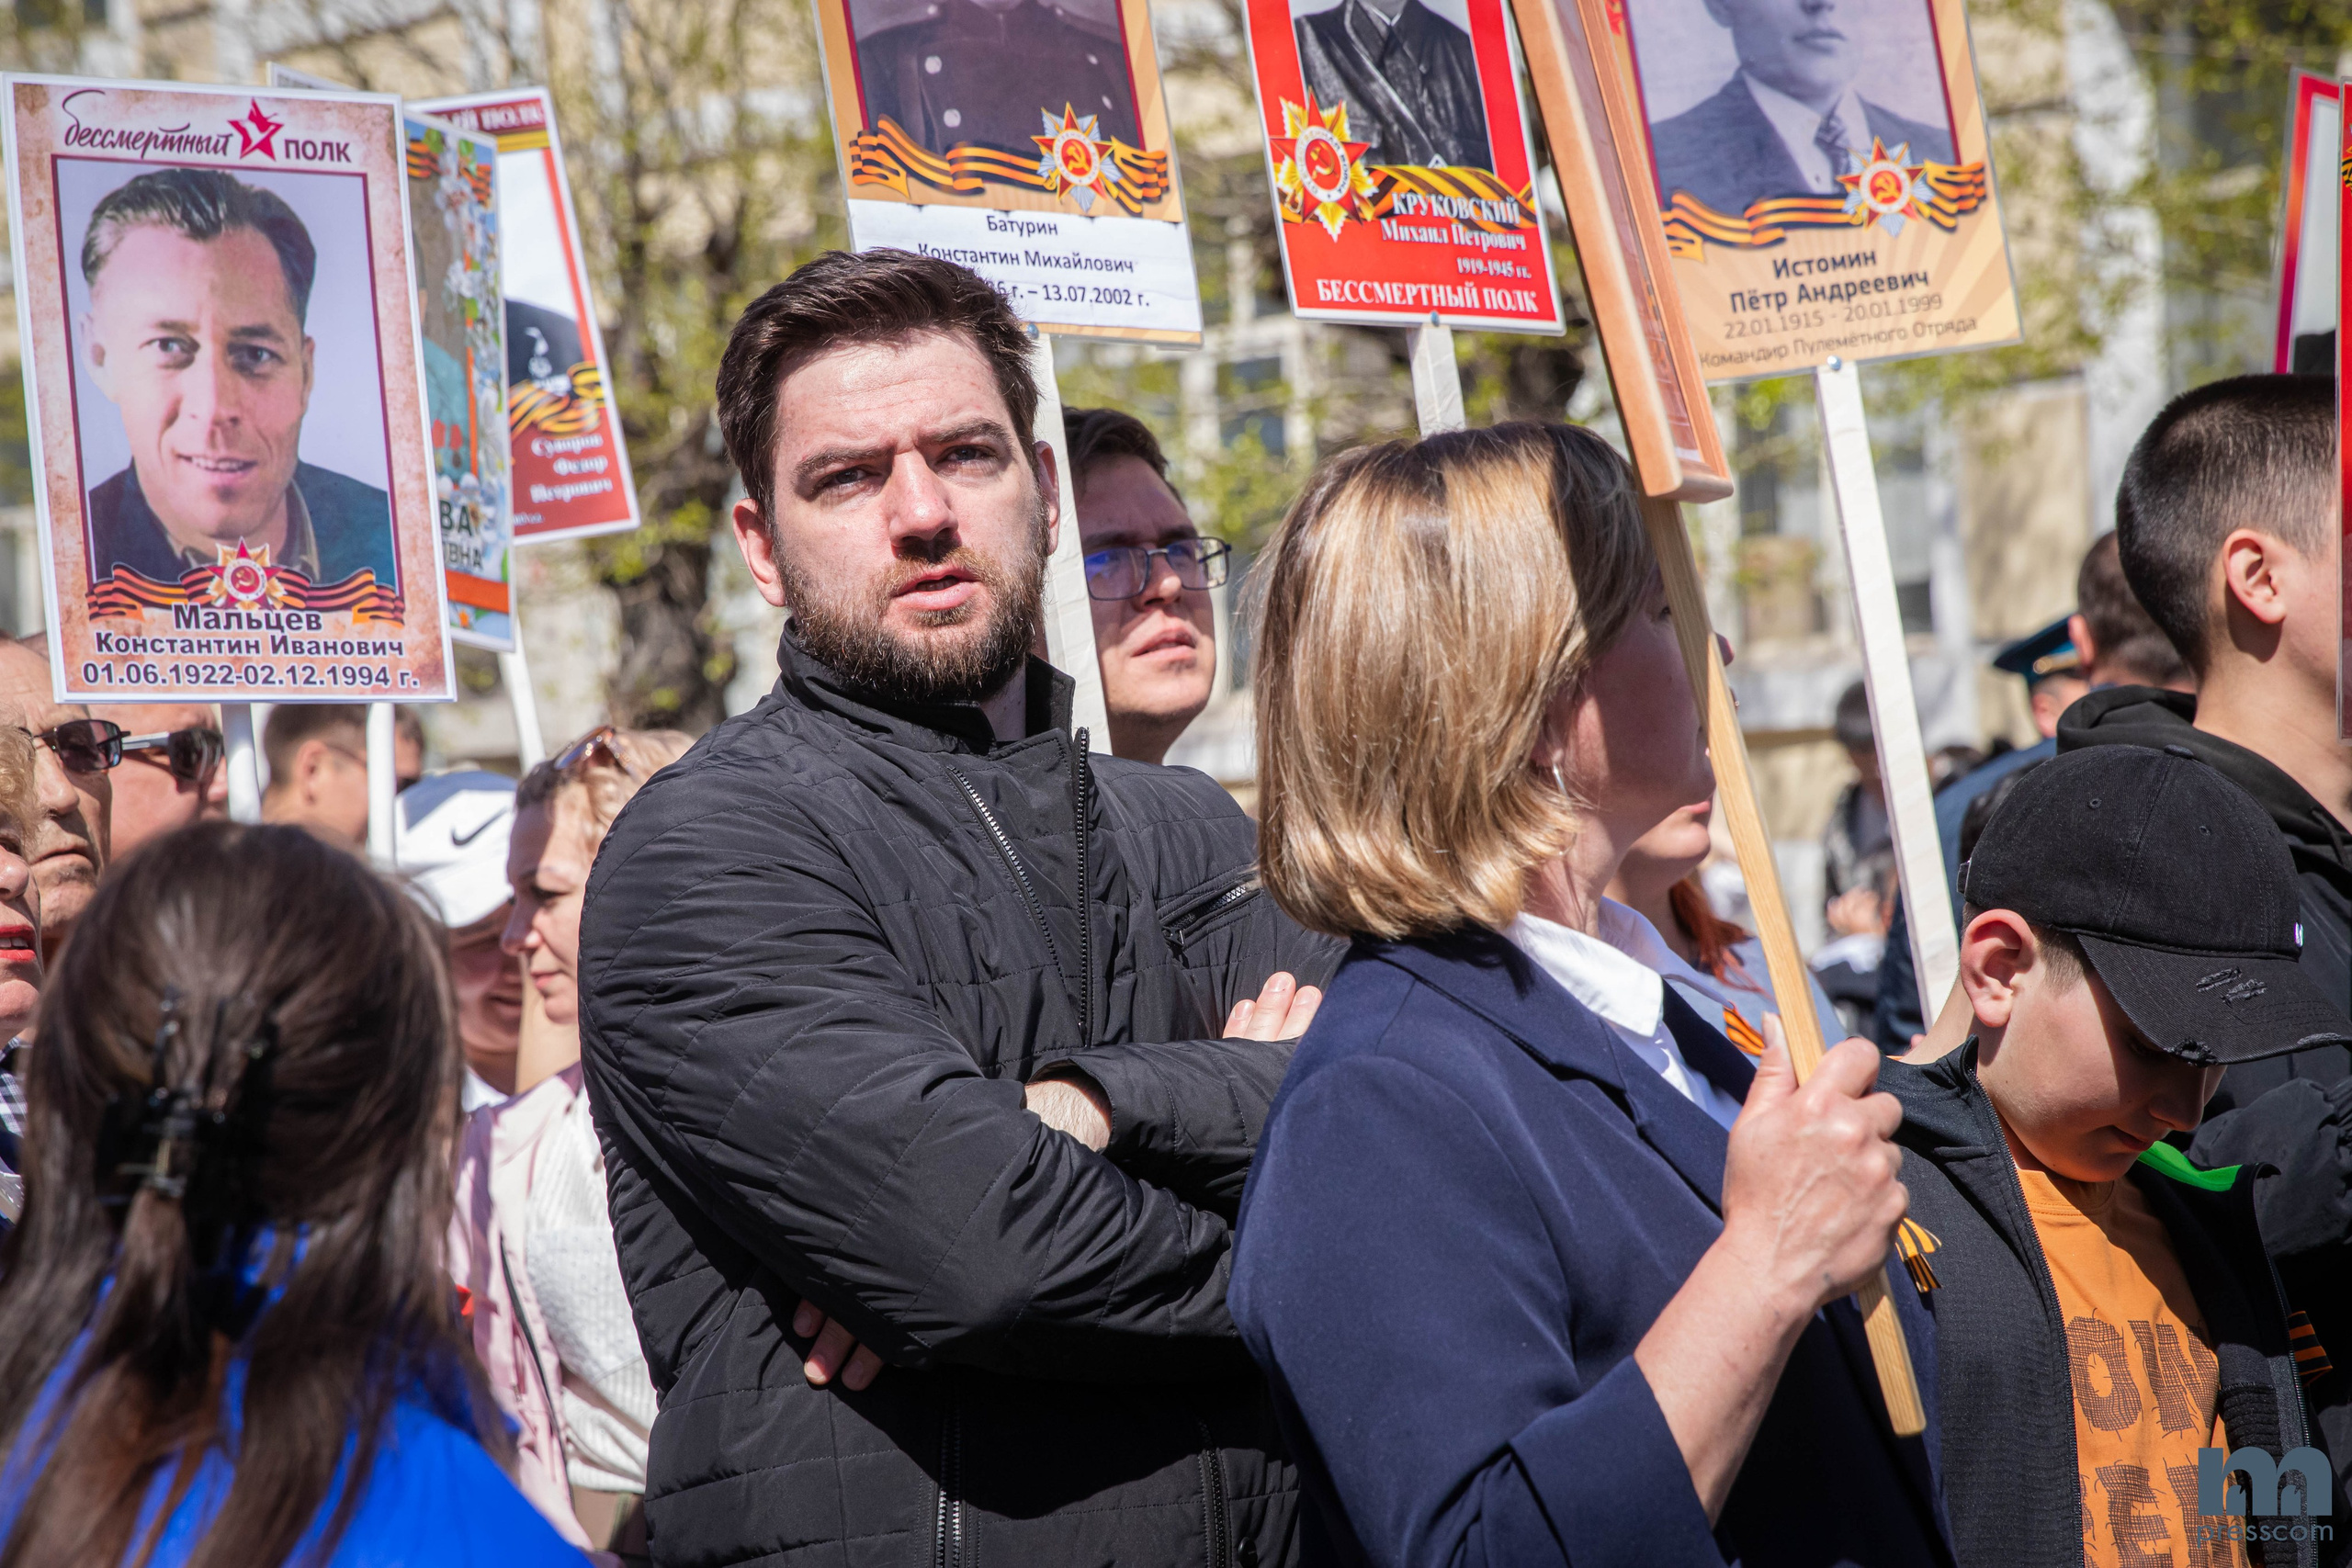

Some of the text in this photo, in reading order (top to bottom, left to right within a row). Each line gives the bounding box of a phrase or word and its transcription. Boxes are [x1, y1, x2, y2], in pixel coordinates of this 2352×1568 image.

[1391, 191, 1521, 224] КРУКОВСКИЙ
[986, 215, 1058, 237] Батурин
[1381, 218, 1527, 253] Михаил Петрович
[918, 243, 1135, 273] Константин Михайлович
[1456, 257, 1514, 277] 1919-1945
[1772, 250, 1877, 279] Истомин
[1043, 284, 1133, 306] 13.07.2002
[1137, 294, 1149, 307] г.
[1317, 278, 1539, 313] БЕССМЕРТНЫЙ ПОЛК
[1730, 271, 1929, 314] Пётр Андреевич
[1911, 316, 1977, 342] Отряда
[173, 604, 323, 633] Мальцев
[96, 632, 404, 657] Константин Иванович
[82, 661, 421, 688] 01.06.1922-02.12.1994 г.
